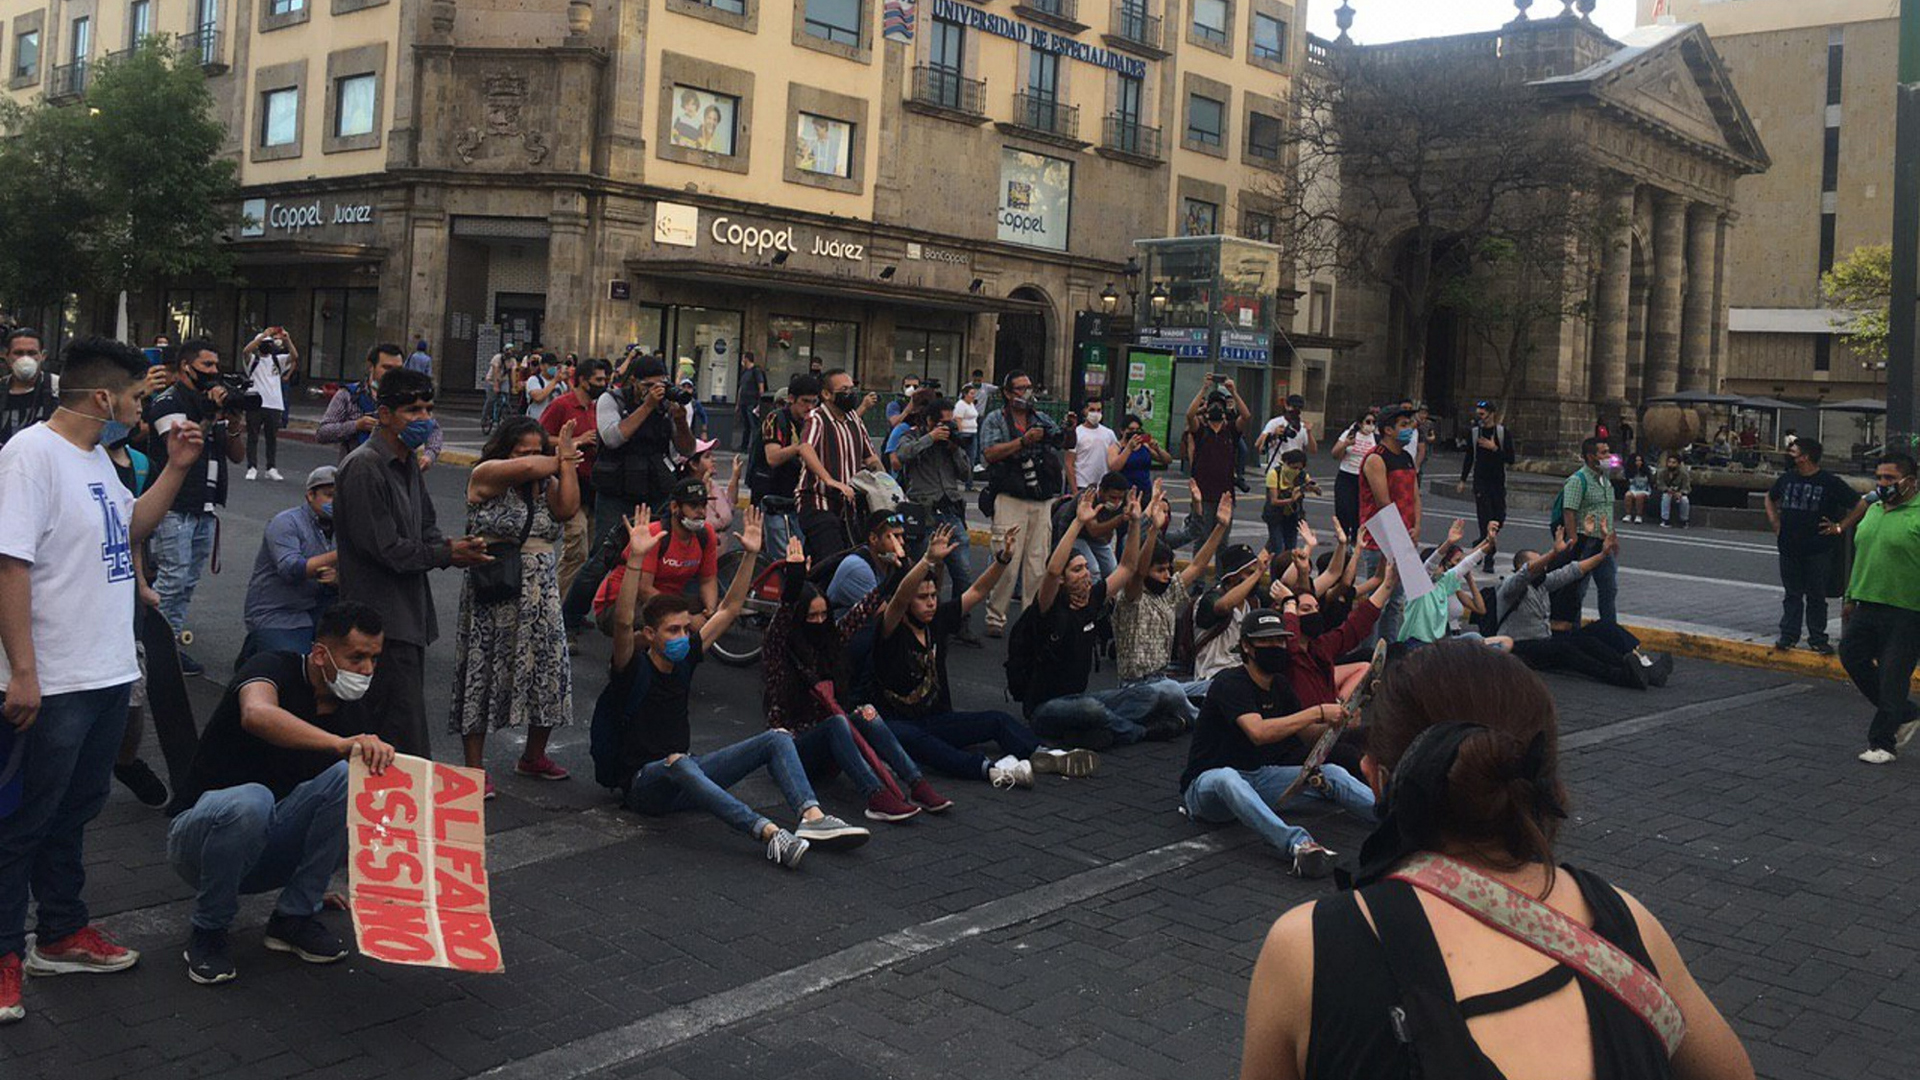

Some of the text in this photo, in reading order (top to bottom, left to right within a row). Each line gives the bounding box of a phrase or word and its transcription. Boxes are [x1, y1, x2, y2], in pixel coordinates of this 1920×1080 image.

[932, 0, 1146, 79] UNIVERSIDAD DE ESPECIALIDADES
[270, 200, 371, 234] Coppel Juárez
[712, 217, 864, 261] Coppel Juárez
[88, 482, 136, 583] LA
[355, 764, 436, 961] ASESINO
[434, 763, 499, 972] ALFARO
